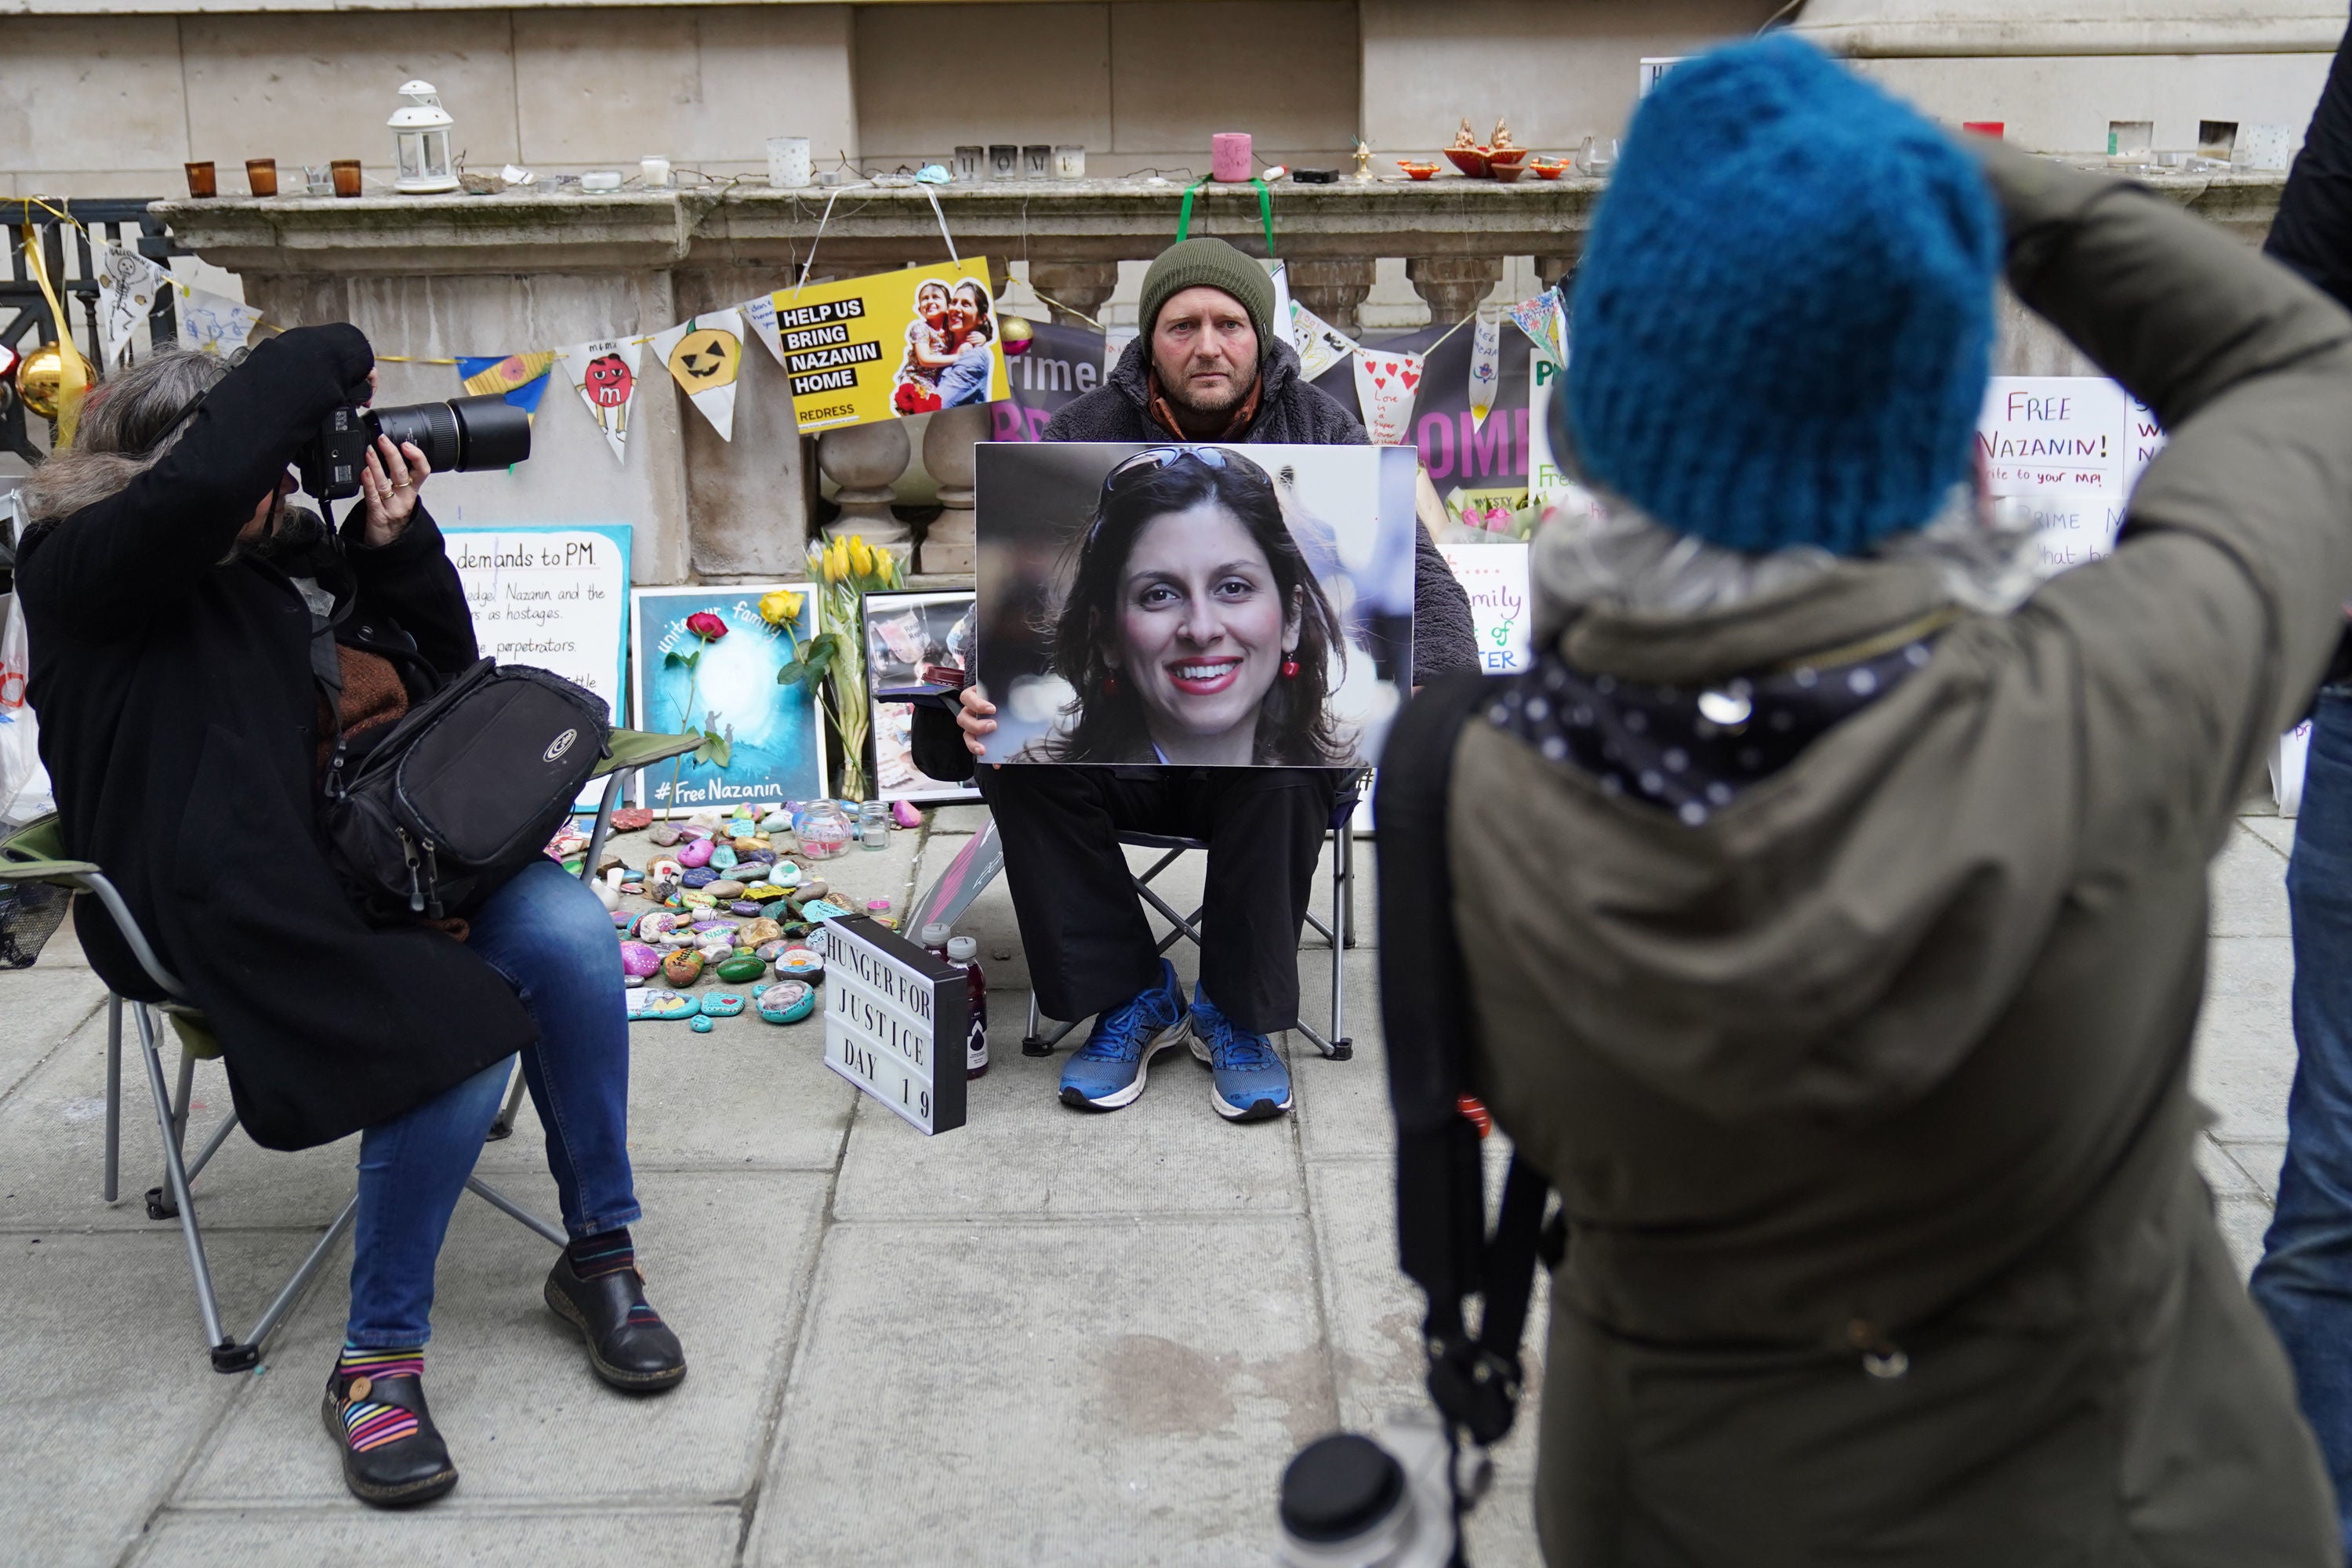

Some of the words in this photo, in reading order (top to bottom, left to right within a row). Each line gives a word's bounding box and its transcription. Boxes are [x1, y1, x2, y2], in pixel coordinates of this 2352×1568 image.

[783, 304, 832, 327] HELP
[835, 299, 862, 318] US
[787, 325, 847, 350] BRING
[791, 343, 877, 372] NAZANIN
[1005, 348, 1097, 393] rime
[794, 370, 854, 394] HOME
[1374, 390, 1399, 403] Love
[2007, 391, 2071, 422] FREE
[799, 404, 855, 422] REDRESS
[2017, 468, 2030, 480] to
[2038, 472, 2066, 484] your
[2075, 474, 2102, 488] MP!
[456, 543, 534, 570] demands
[541, 547, 561, 566] to
[506, 582, 552, 601] Nazanin
[557, 582, 579, 600] and
[587, 583, 606, 600] the
[488, 612, 501, 621] as
[506, 603, 564, 628] hostages.
[496, 637, 577, 662] perpetrators.
[827, 933, 894, 996] HUNGER
[899, 974, 931, 1022] FOR
[839, 987, 924, 1066] JUSTICE
[844, 1037, 877, 1082] DAY
